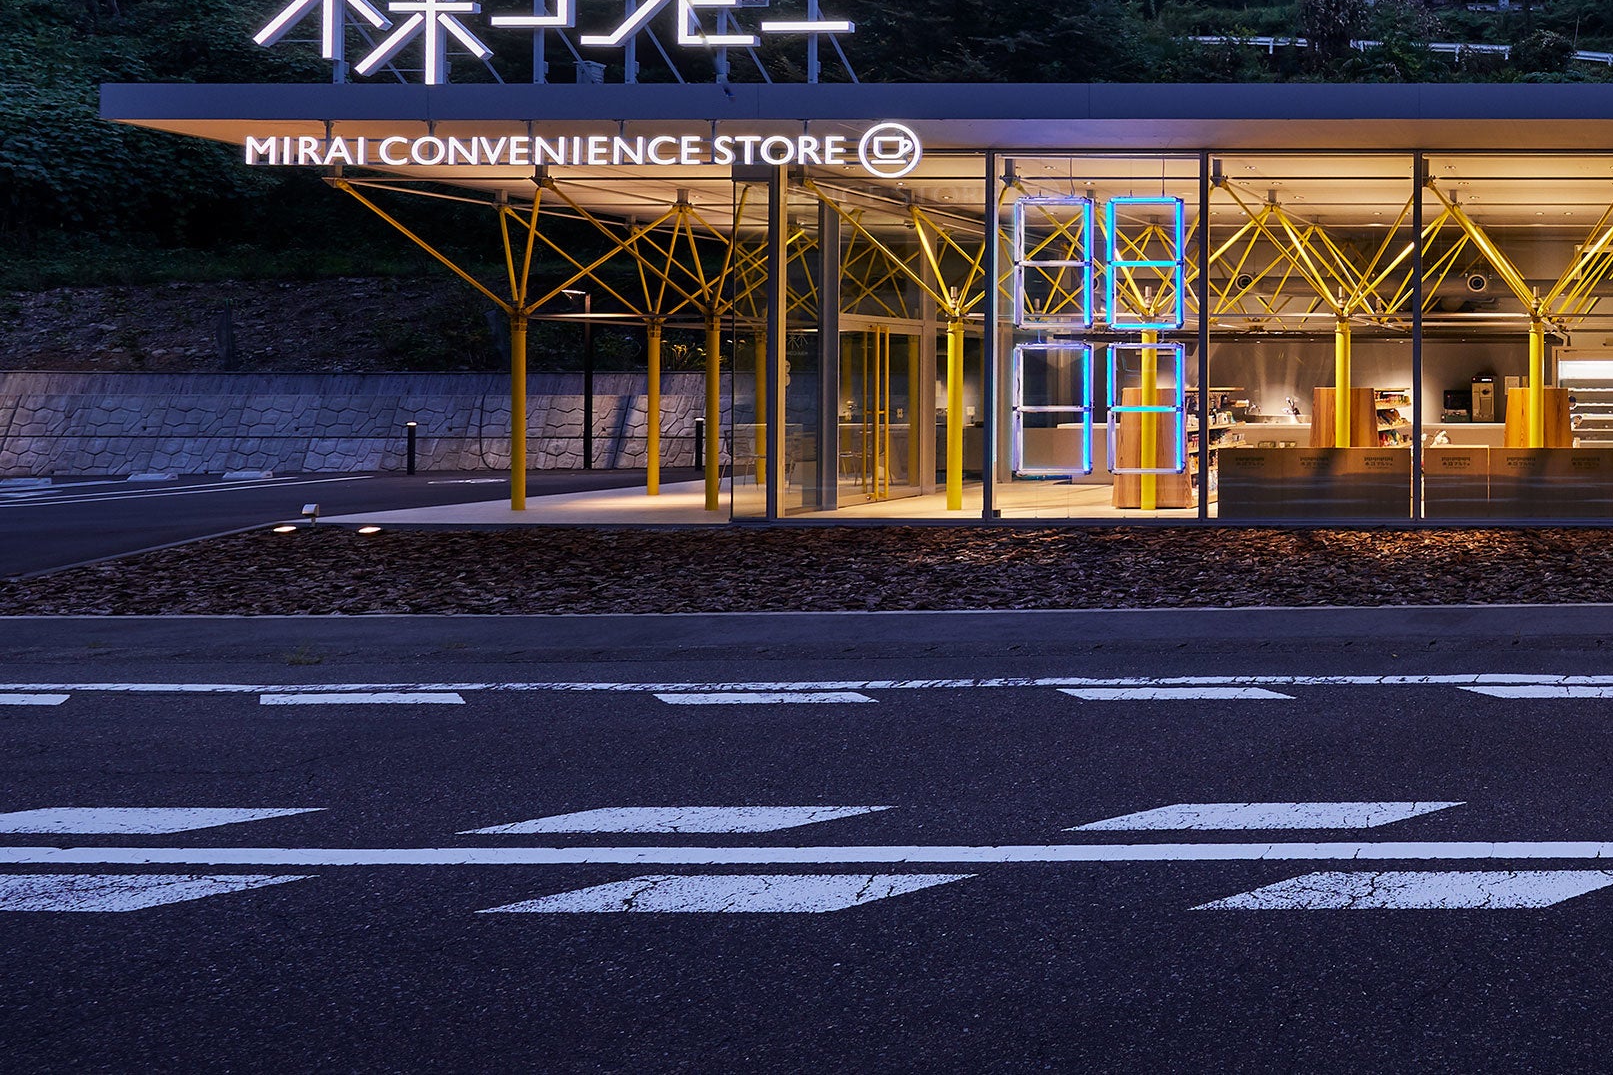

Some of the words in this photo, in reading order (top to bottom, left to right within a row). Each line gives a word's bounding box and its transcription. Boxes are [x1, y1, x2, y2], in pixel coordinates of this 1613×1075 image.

[245, 135, 366, 165] MIRAI
[379, 135, 701, 165] CONVENIENCE
[713, 135, 845, 165] STORE
